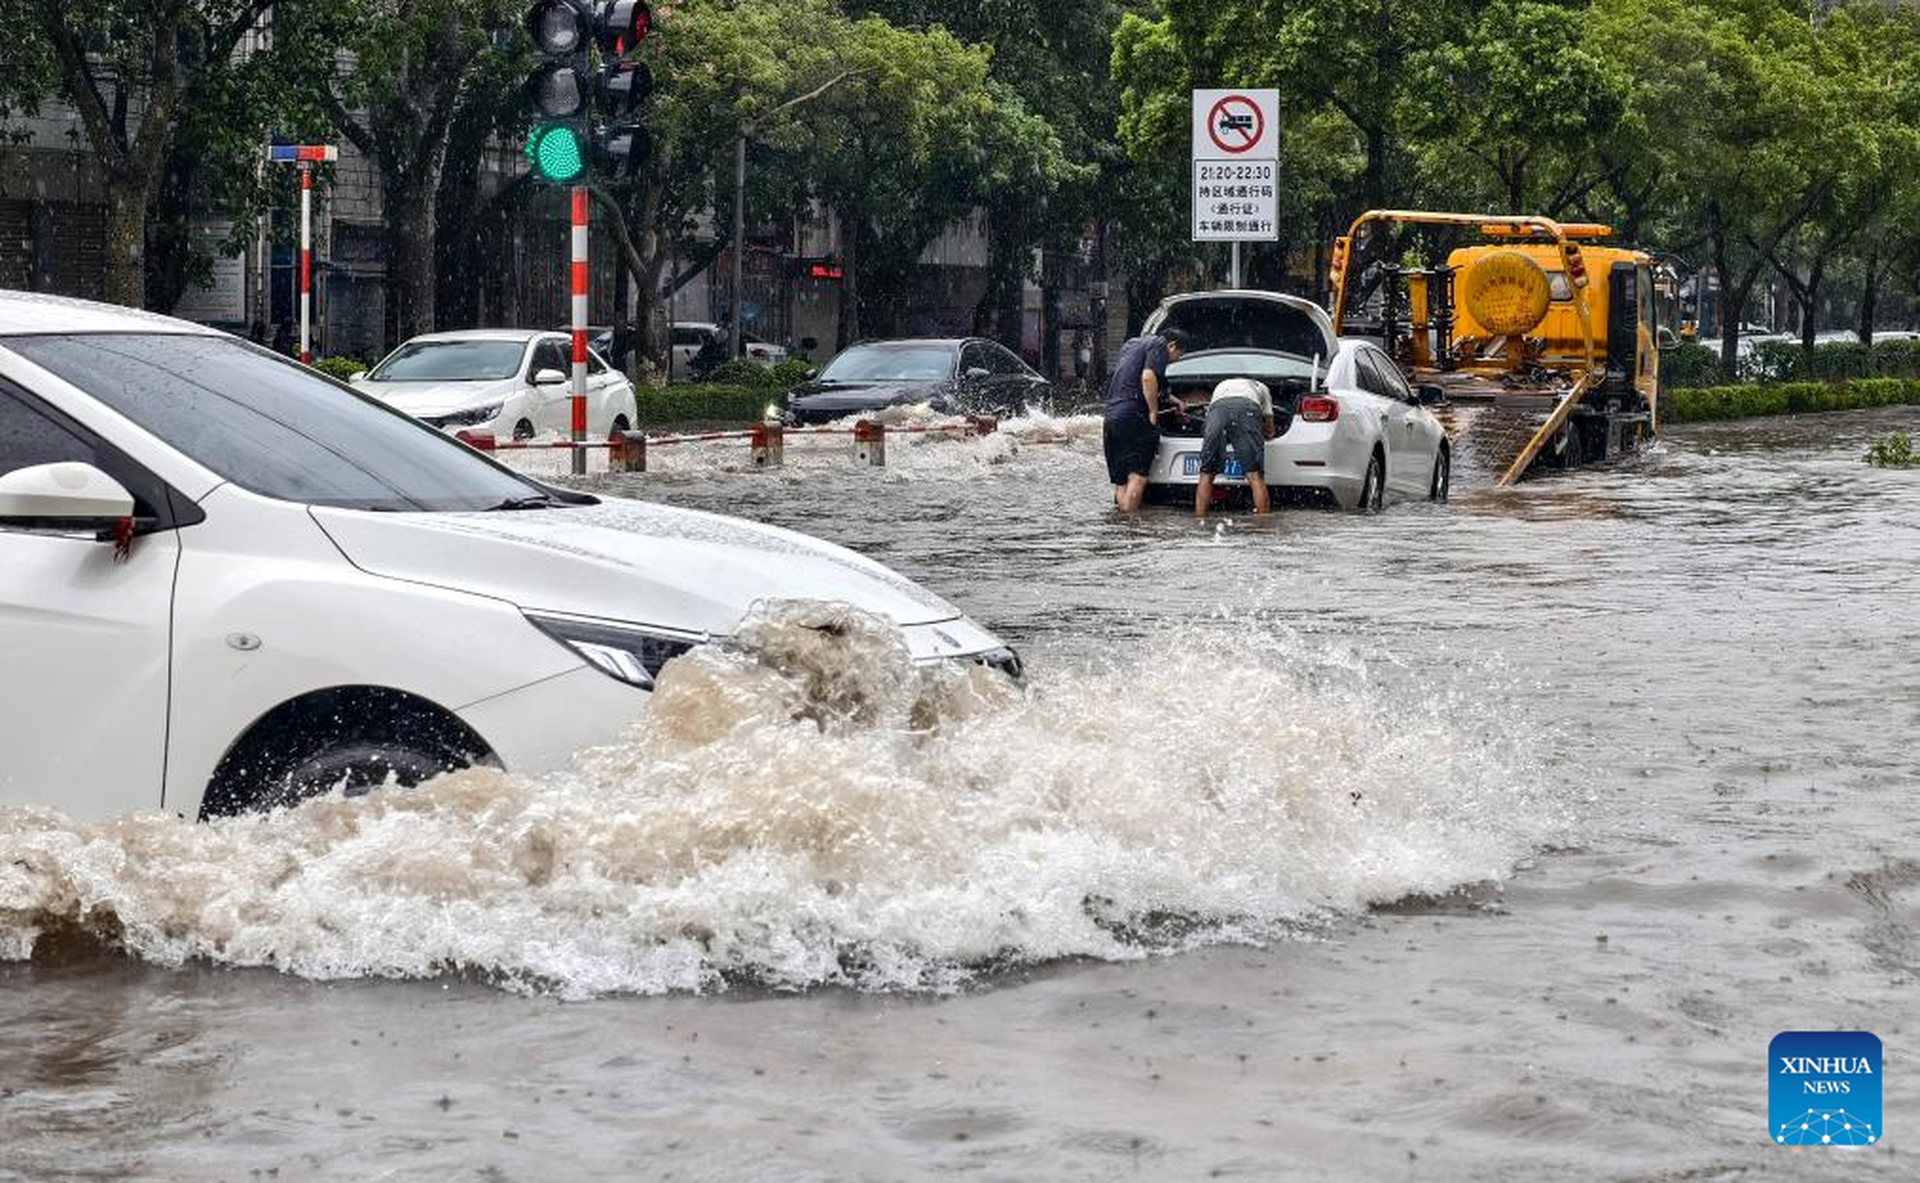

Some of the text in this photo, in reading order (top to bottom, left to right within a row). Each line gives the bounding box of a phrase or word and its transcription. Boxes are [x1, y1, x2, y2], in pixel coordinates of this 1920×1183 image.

[1201, 166, 1271, 179] 21:20-22:30
[1199, 185, 1272, 198] 持区域通行码
[1199, 220, 1271, 232] 车辆限制通行
